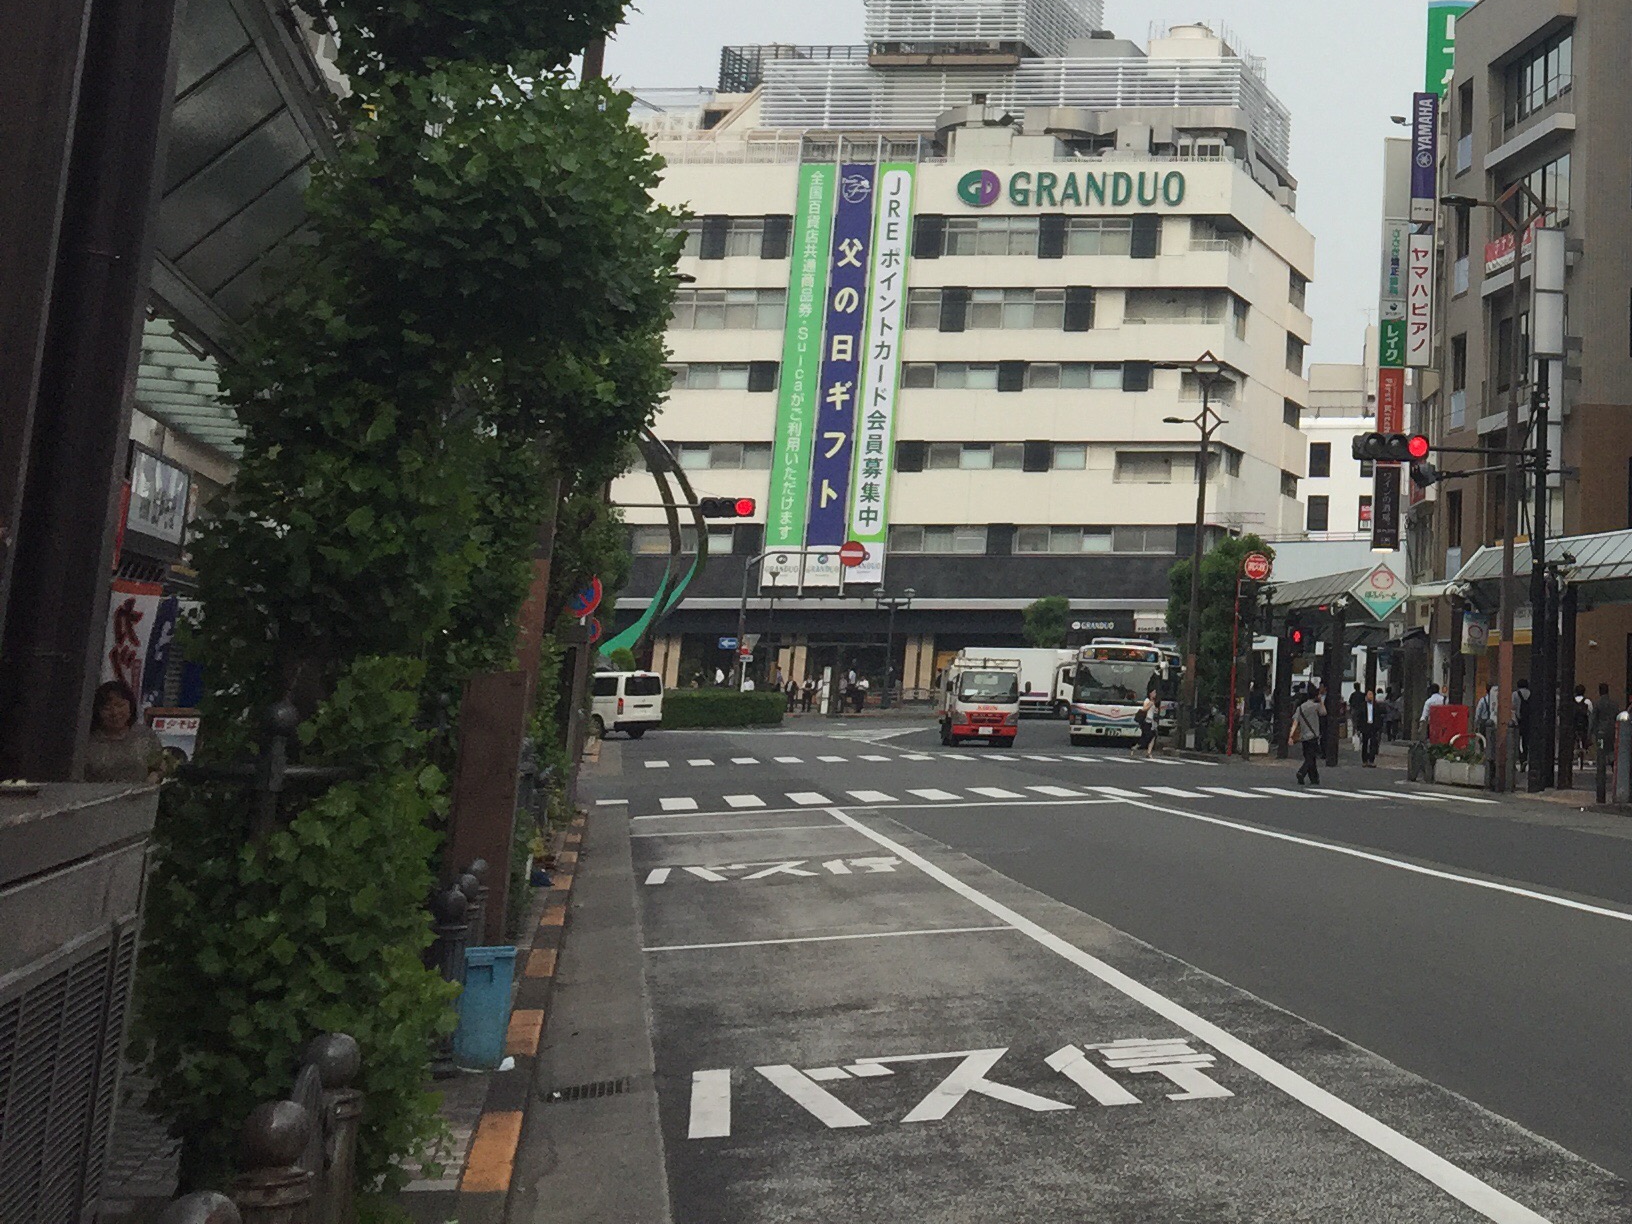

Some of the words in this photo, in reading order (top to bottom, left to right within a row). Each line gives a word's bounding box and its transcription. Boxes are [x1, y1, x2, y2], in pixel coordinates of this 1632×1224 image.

[1417, 98, 1433, 151] YAMAHA
[1008, 170, 1187, 207] GRANDUO
[1410, 247, 1429, 353] ヤマハピアノ
[1385, 324, 1398, 362] レイク
[819, 237, 864, 509] 父の日ギフト
[644, 856, 905, 885] バス停
[687, 1037, 1236, 1139] バス停
